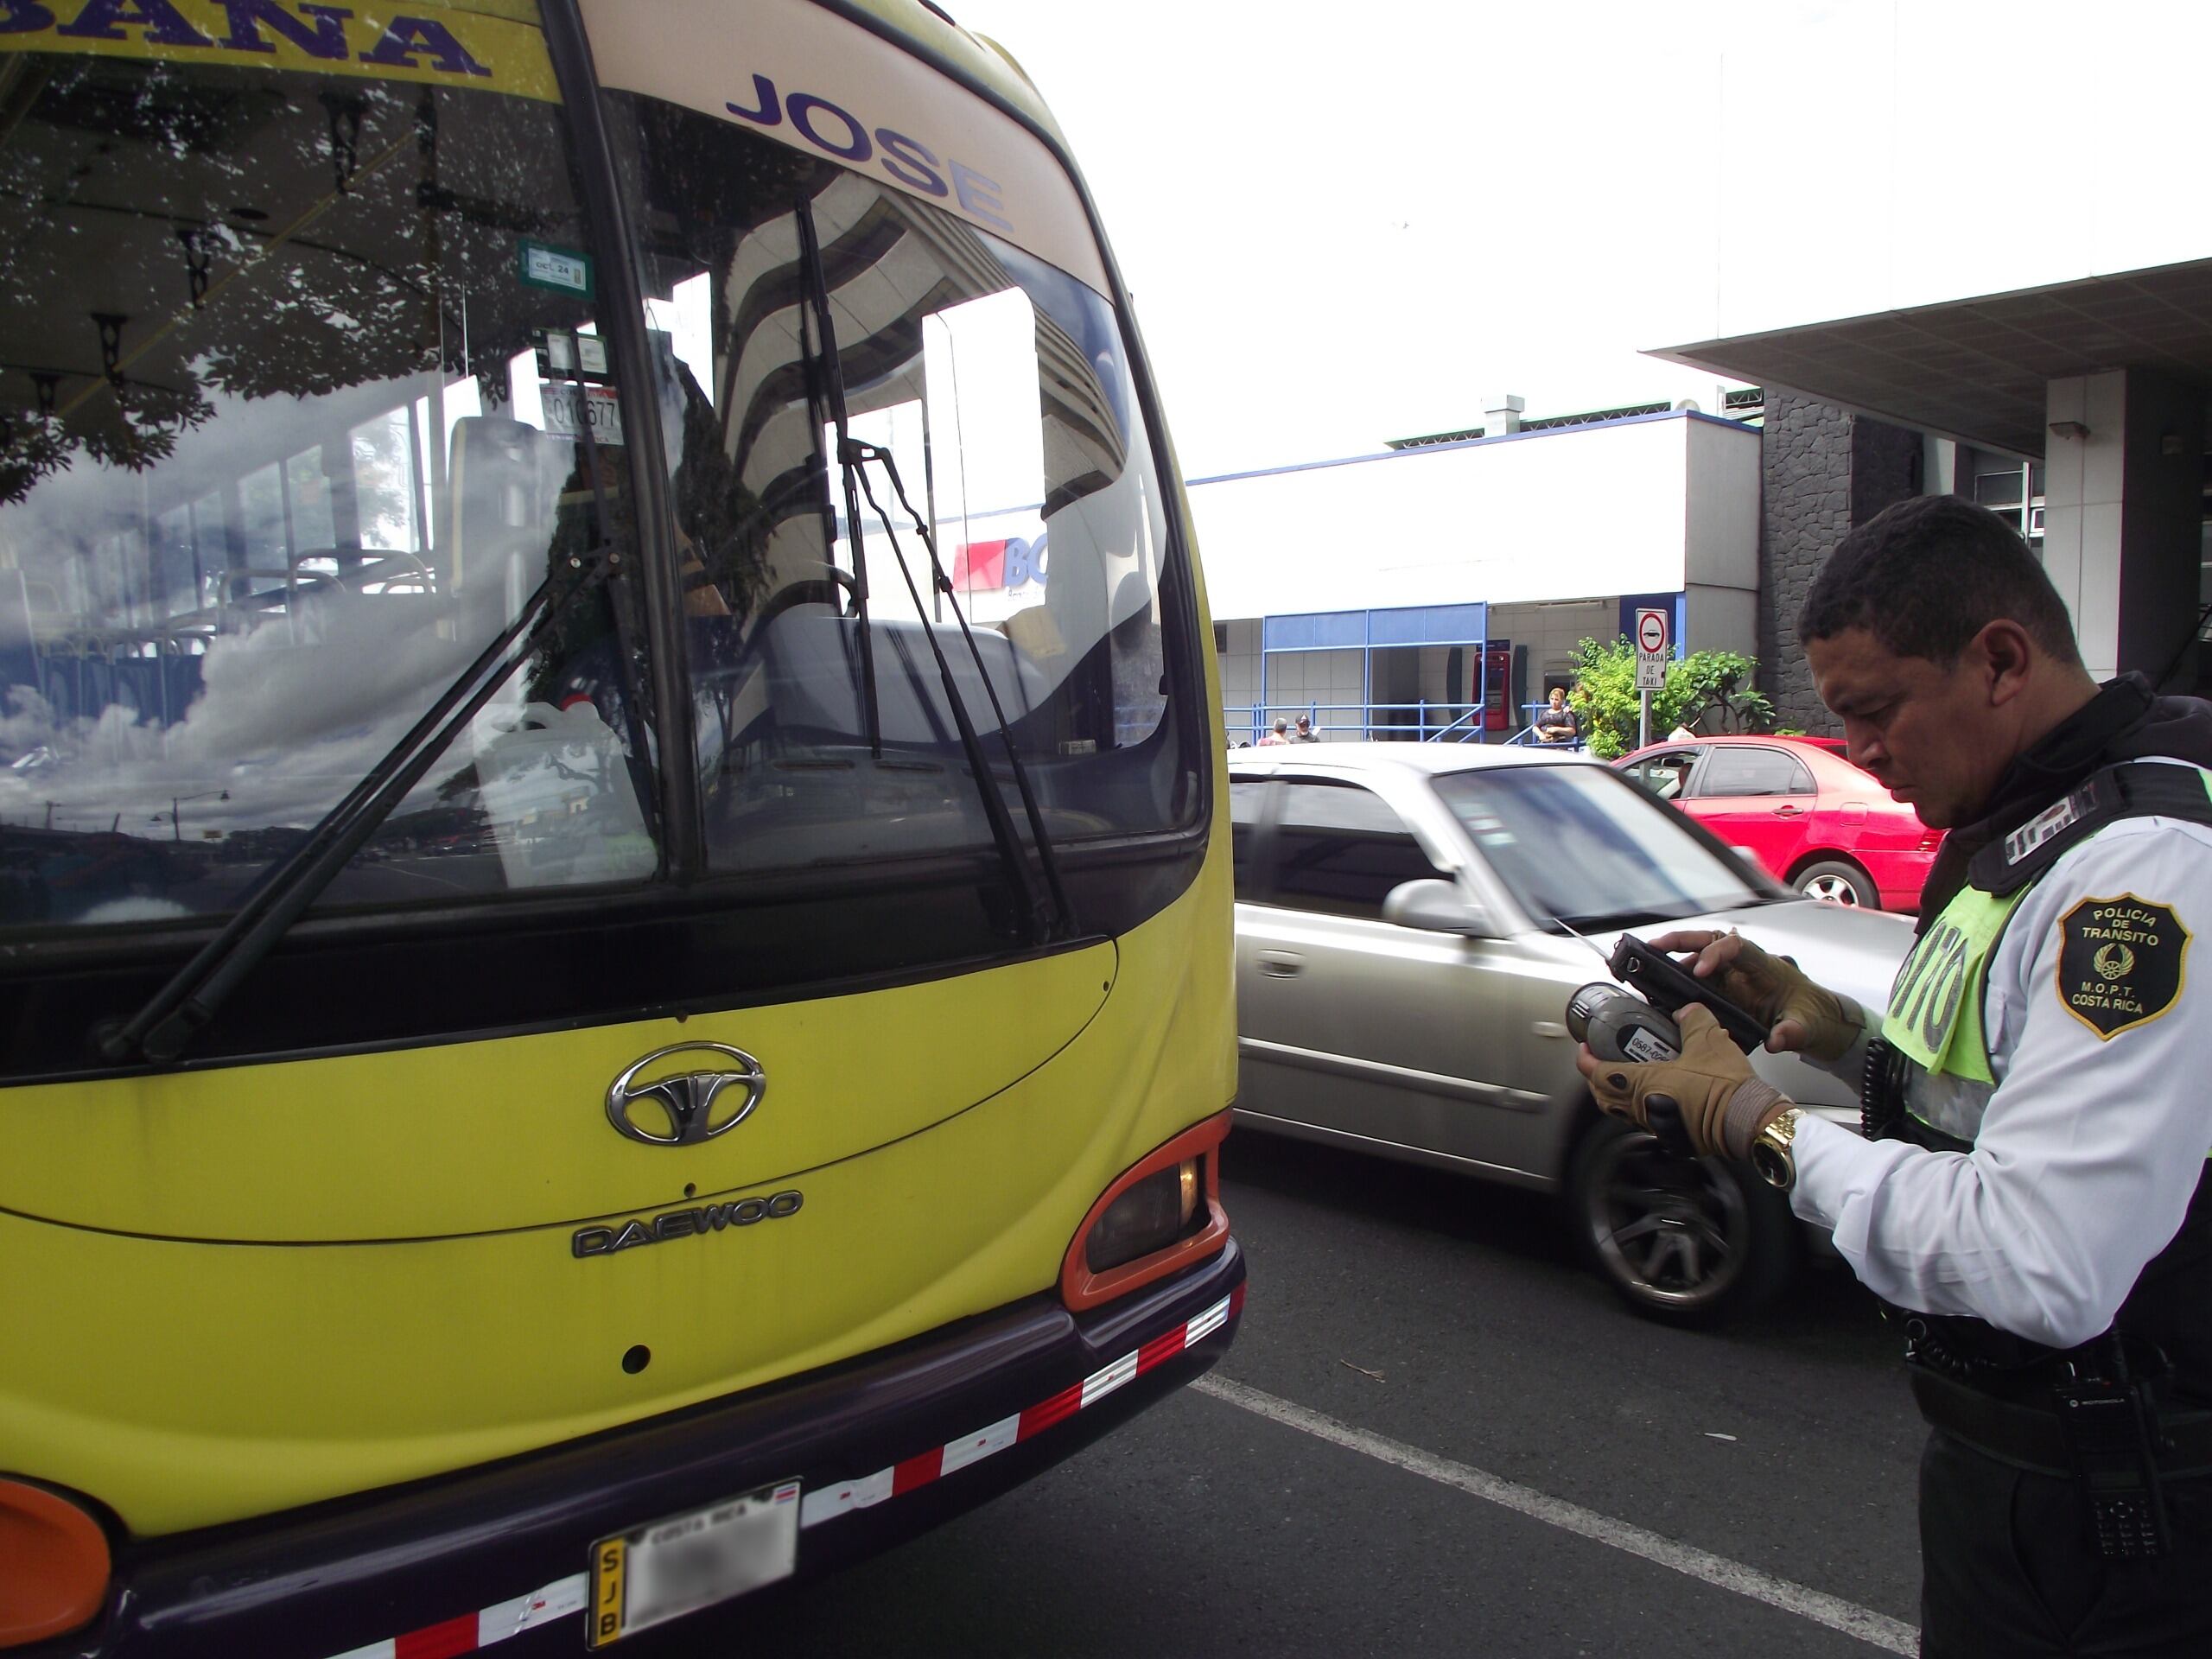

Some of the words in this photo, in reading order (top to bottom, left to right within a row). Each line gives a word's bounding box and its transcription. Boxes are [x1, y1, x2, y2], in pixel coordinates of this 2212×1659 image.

[726, 73, 1014, 233] JOSE
[557, 265, 569, 274] 24
[1639, 652, 1664, 662] PARADA
[1646, 665, 1655, 674] DE
[1643, 677, 1656, 686] TAXI
[2093, 908, 2157, 927] POLICIA
[2112, 919, 2130, 929] DE
[2082, 927, 2158, 946] TRANSITO
[2082, 982, 2135, 998] M.O.P.T.
[2072, 994, 2110, 1009] COSTA
[2113, 999, 2143, 1014] RICA
[572, 1189, 804, 1259] DAEWOO
